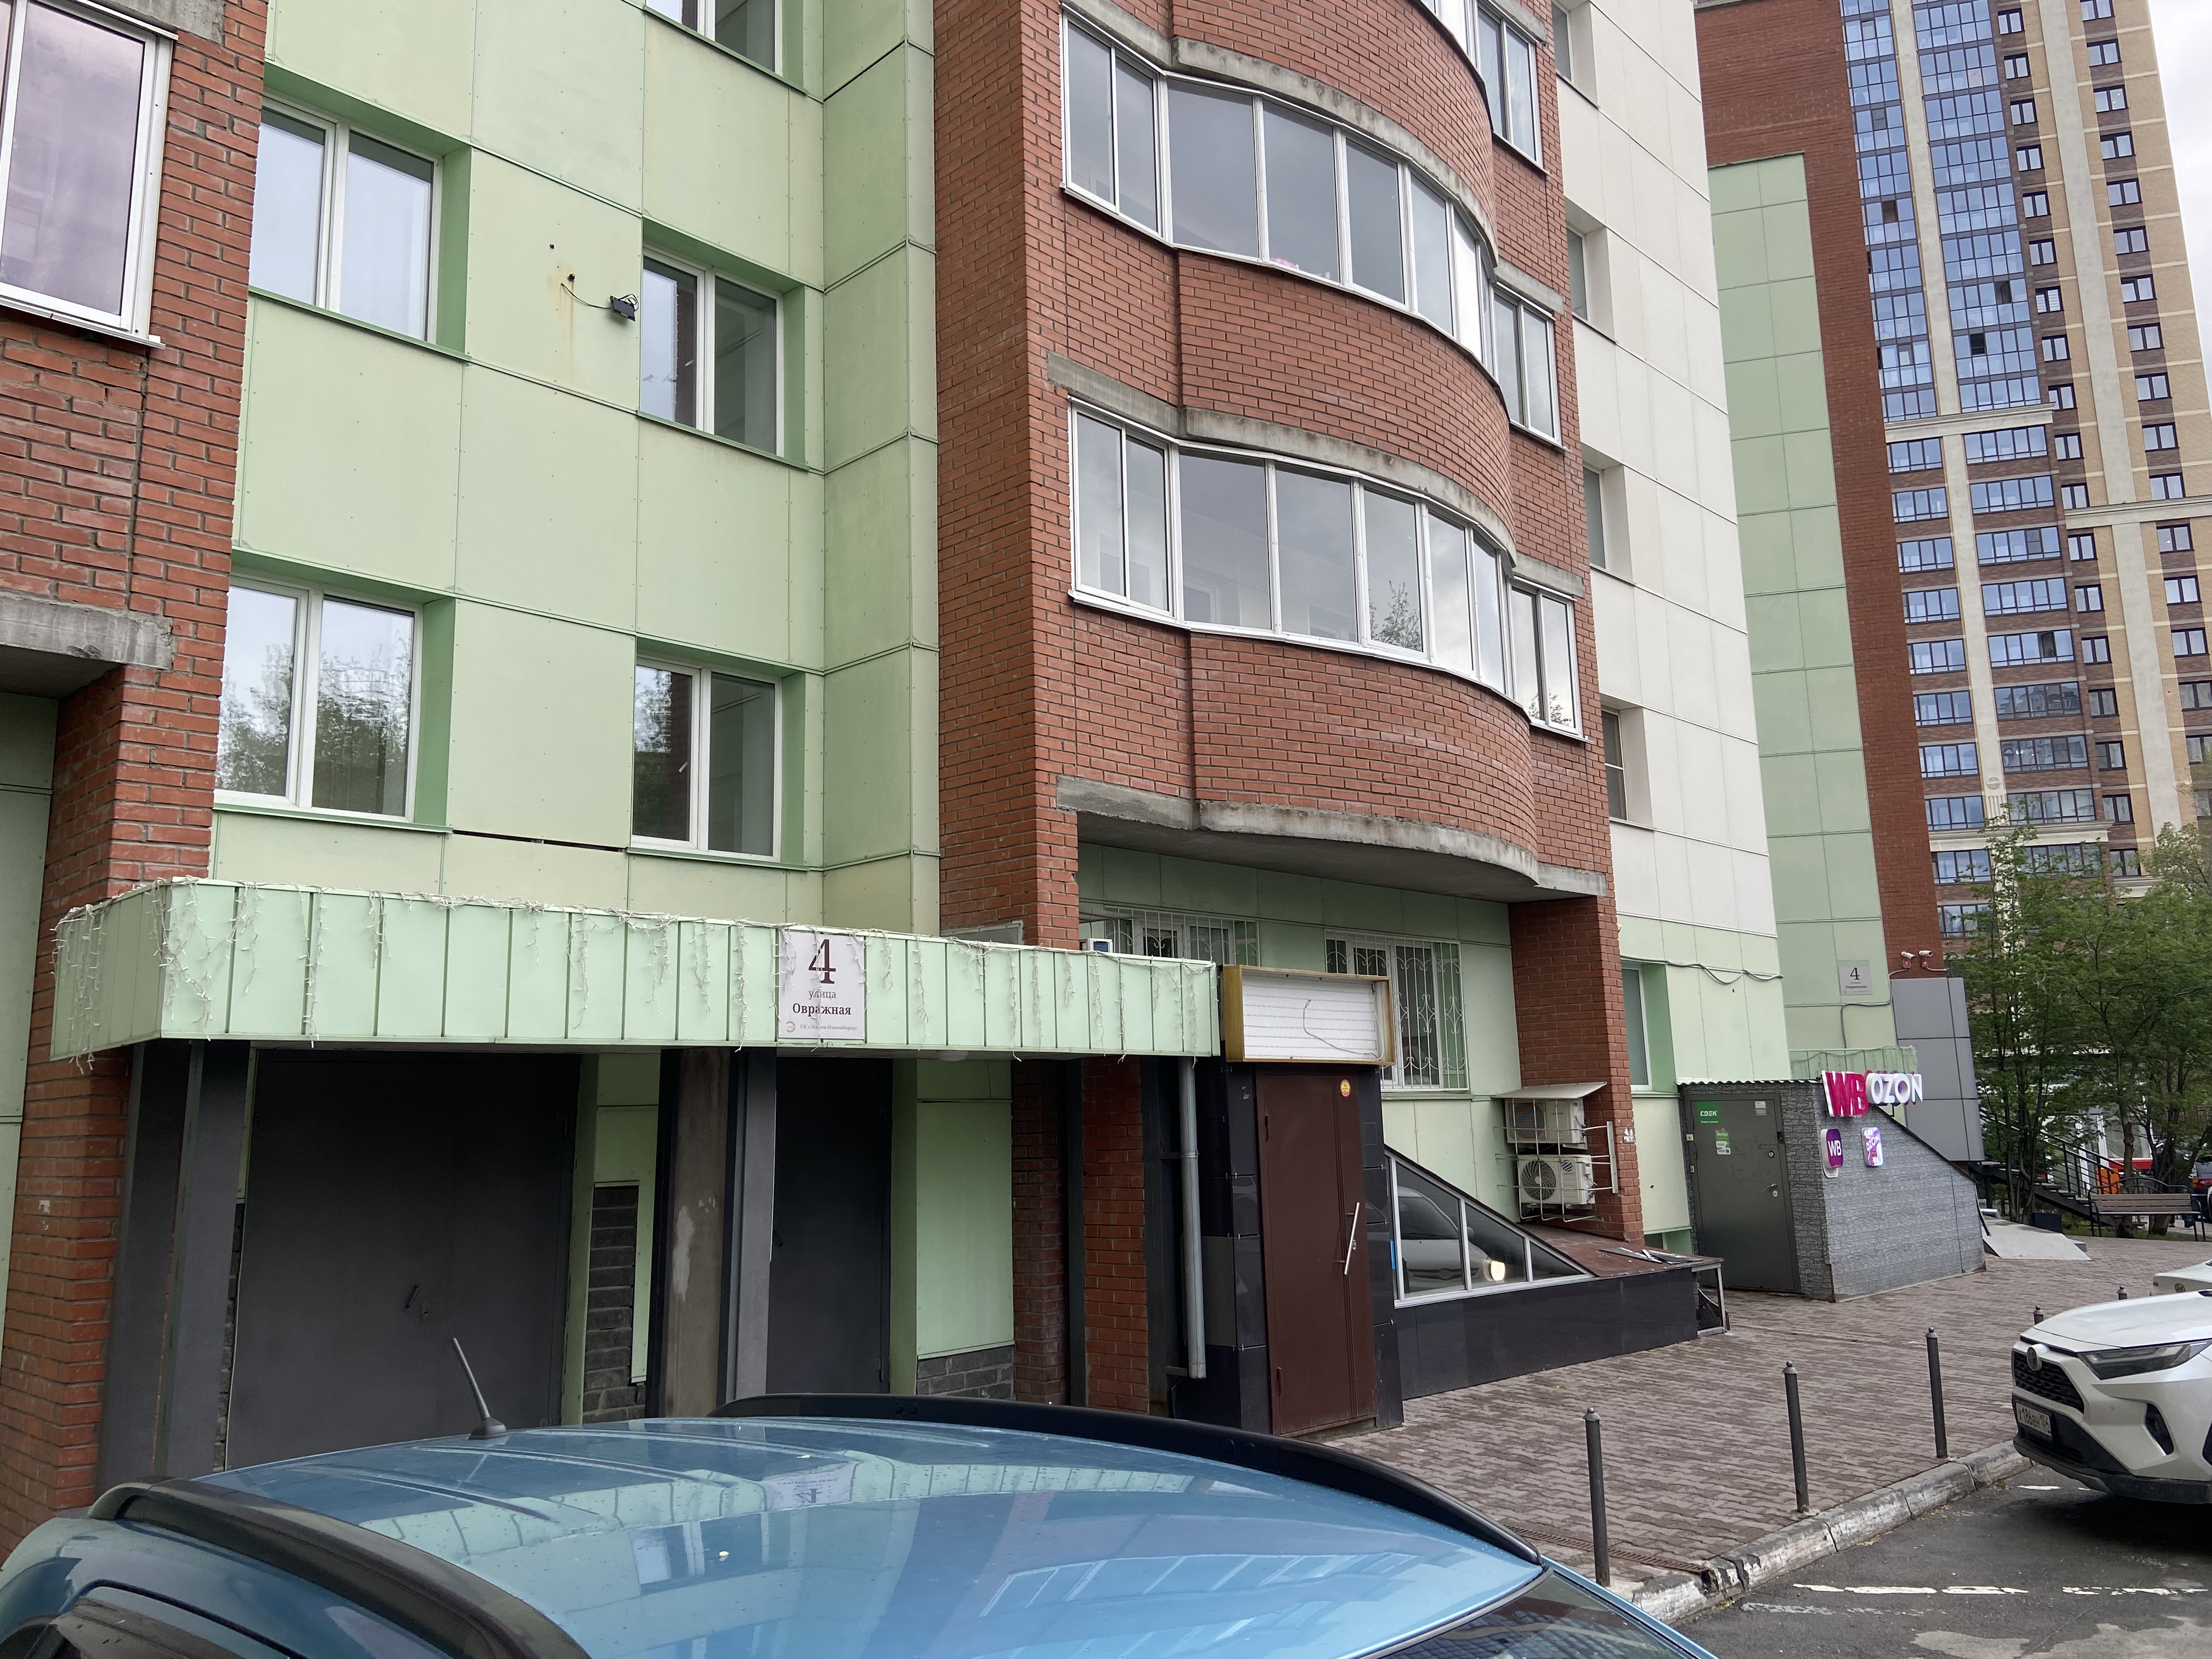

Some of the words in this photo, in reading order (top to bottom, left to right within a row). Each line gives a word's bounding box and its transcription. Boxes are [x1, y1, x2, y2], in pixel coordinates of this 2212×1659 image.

[808, 939, 836, 984] 4
[1849, 967, 1860, 980] 4
[809, 989, 837, 1000] улица
[792, 1003, 851, 1017] Овражная
[1821, 1070, 1869, 1117] WB
[1866, 1073, 1923, 1104] OZON
[1827, 1140, 1842, 1156] WB
